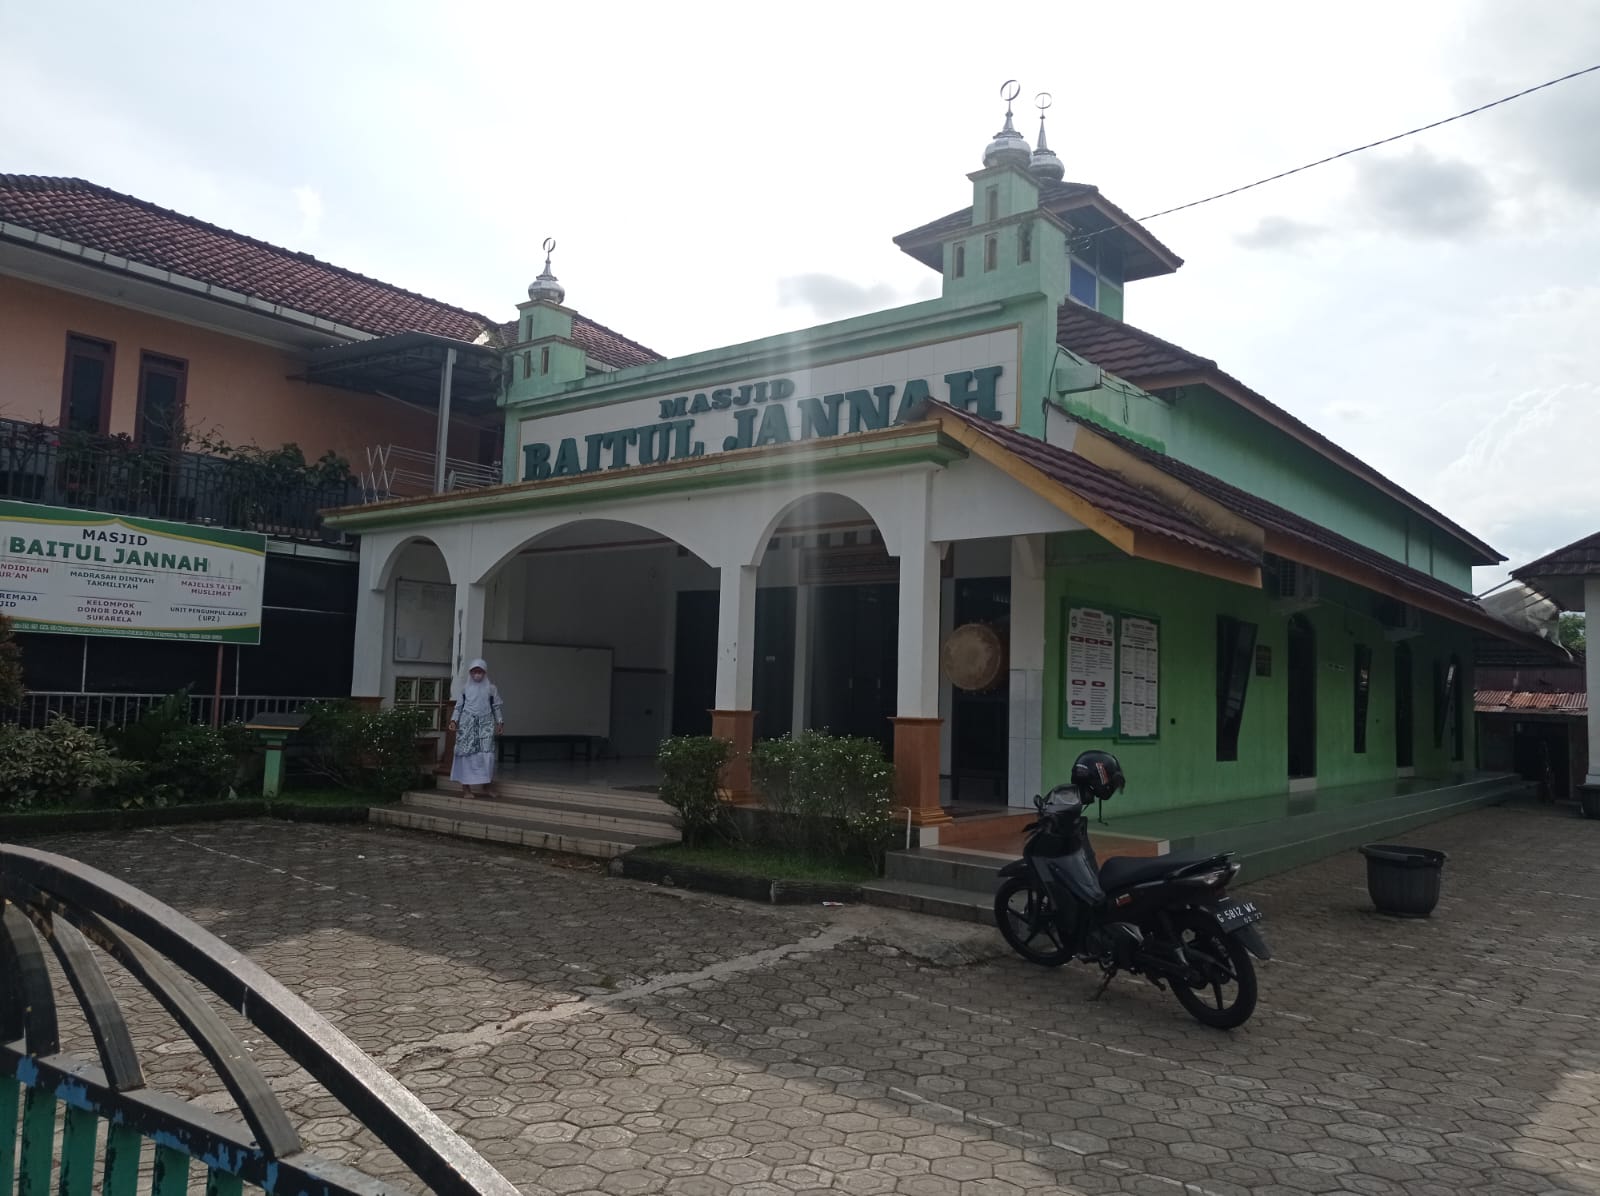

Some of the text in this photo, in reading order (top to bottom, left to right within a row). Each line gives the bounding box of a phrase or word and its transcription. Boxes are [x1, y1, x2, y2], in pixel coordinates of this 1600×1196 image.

[659, 378, 795, 418] MASJID
[522, 365, 1004, 481] BAITUL JANNAH
[82, 529, 148, 546] MASJID
[9, 536, 208, 573] BAITUL JANNAH
[70, 571, 154, 584] MADRASAH DINIYAH
[87, 580, 138, 589] TAKMILIYAH
[181, 580, 214, 589] MAJELIS
[191, 589, 232, 597] MUSLIMAT
[86, 599, 135, 609] KELOMPOK
[77, 606, 142, 616] DONOR DARAH
[86, 615, 133, 623] SUKARELA
